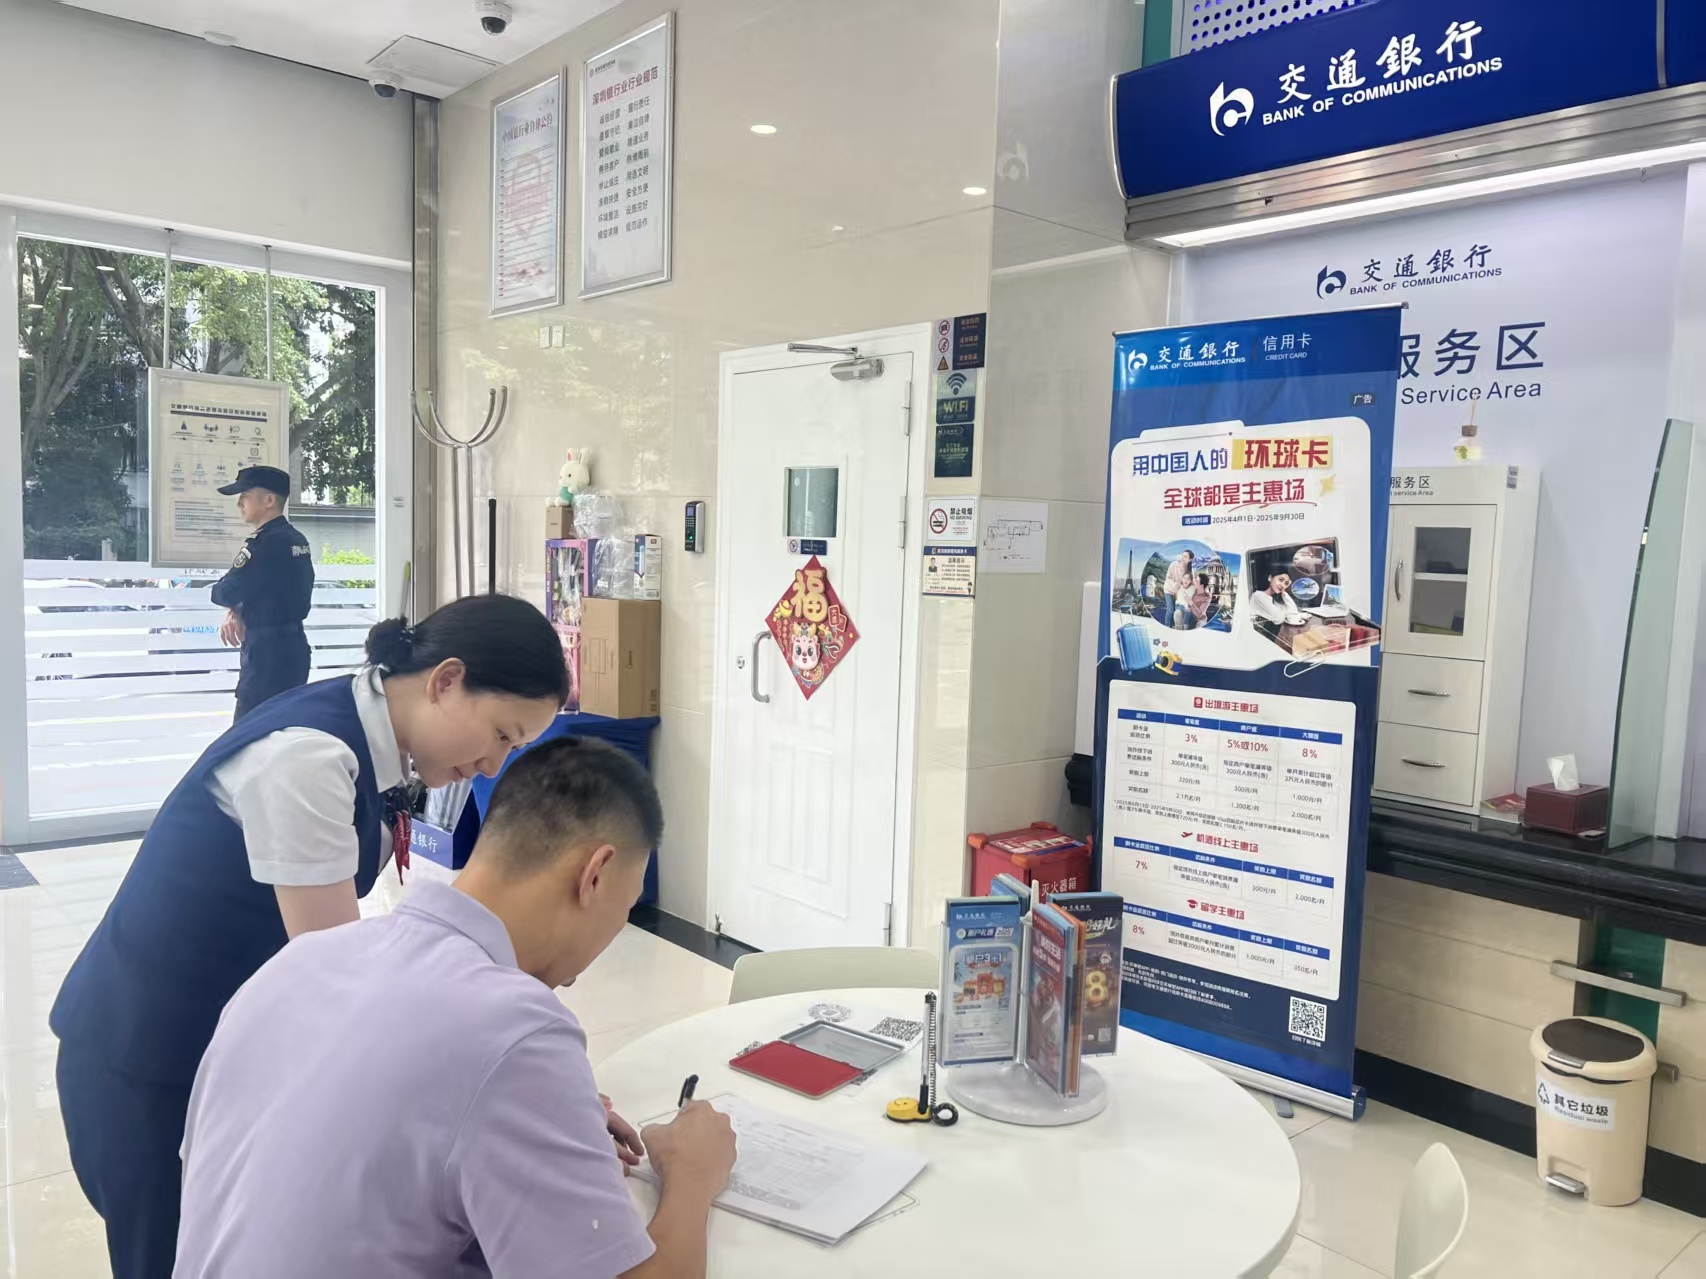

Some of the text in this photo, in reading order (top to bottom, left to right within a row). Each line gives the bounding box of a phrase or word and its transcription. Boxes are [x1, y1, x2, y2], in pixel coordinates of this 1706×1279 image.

[1278, 18, 1482, 104] 交通銀行
[1262, 56, 1502, 126] BANK OF COMMUNICATIONS
[1361, 244, 1492, 282] 交通銀行
[1350, 267, 1502, 295] BANK OF COMMUNICATIONS
[1158, 332, 1313, 363] 交通銀行 信用卡
[1150, 363, 1168, 371] BANK
[1183, 357, 1246, 368] COMMUNICATIONS
[1353, 394, 1373, 405] 广告
[1401, 382, 1541, 405] Service Area
[1132, 439, 1329, 477] 用中国人的 环球卡
[1164, 479, 1305, 510] 全球都是主惠场
[790, 569, 828, 622] 福
[1185, 733, 1198, 743] 3%
[1227, 739, 1268, 752] 5%或10%
[1302, 748, 1317, 758] 8%
[1136, 860, 1148, 870] 7%
[1041, 876, 1077, 897] 灭火器箱
[1201, 902, 1245, 920] 留学主惠场
[1132, 925, 1144, 935] 8%
[1554, 1093, 1608, 1116] 其它垃圾
